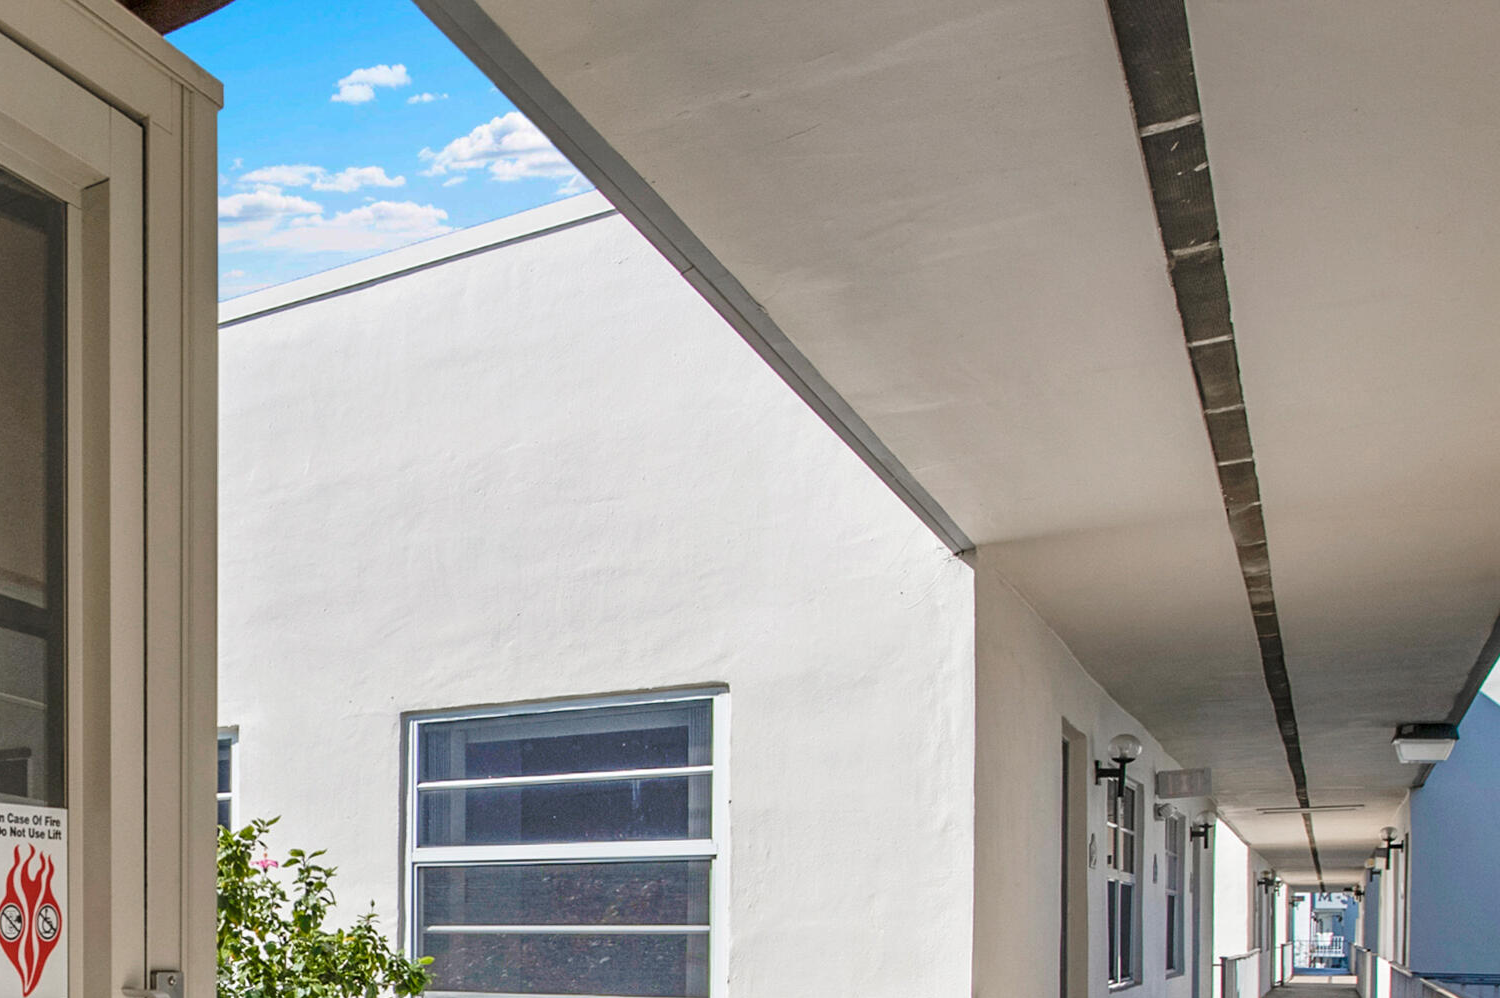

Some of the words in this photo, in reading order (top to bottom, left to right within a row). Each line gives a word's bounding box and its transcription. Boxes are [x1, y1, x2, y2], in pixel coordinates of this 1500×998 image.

[7, 812, 30, 826] Case
[32, 815, 42, 826] Of
[44, 816, 61, 828] Fire
[10, 826, 26, 838] Not
[28, 828, 45, 839] Use
[48, 829, 62, 840] Lift
